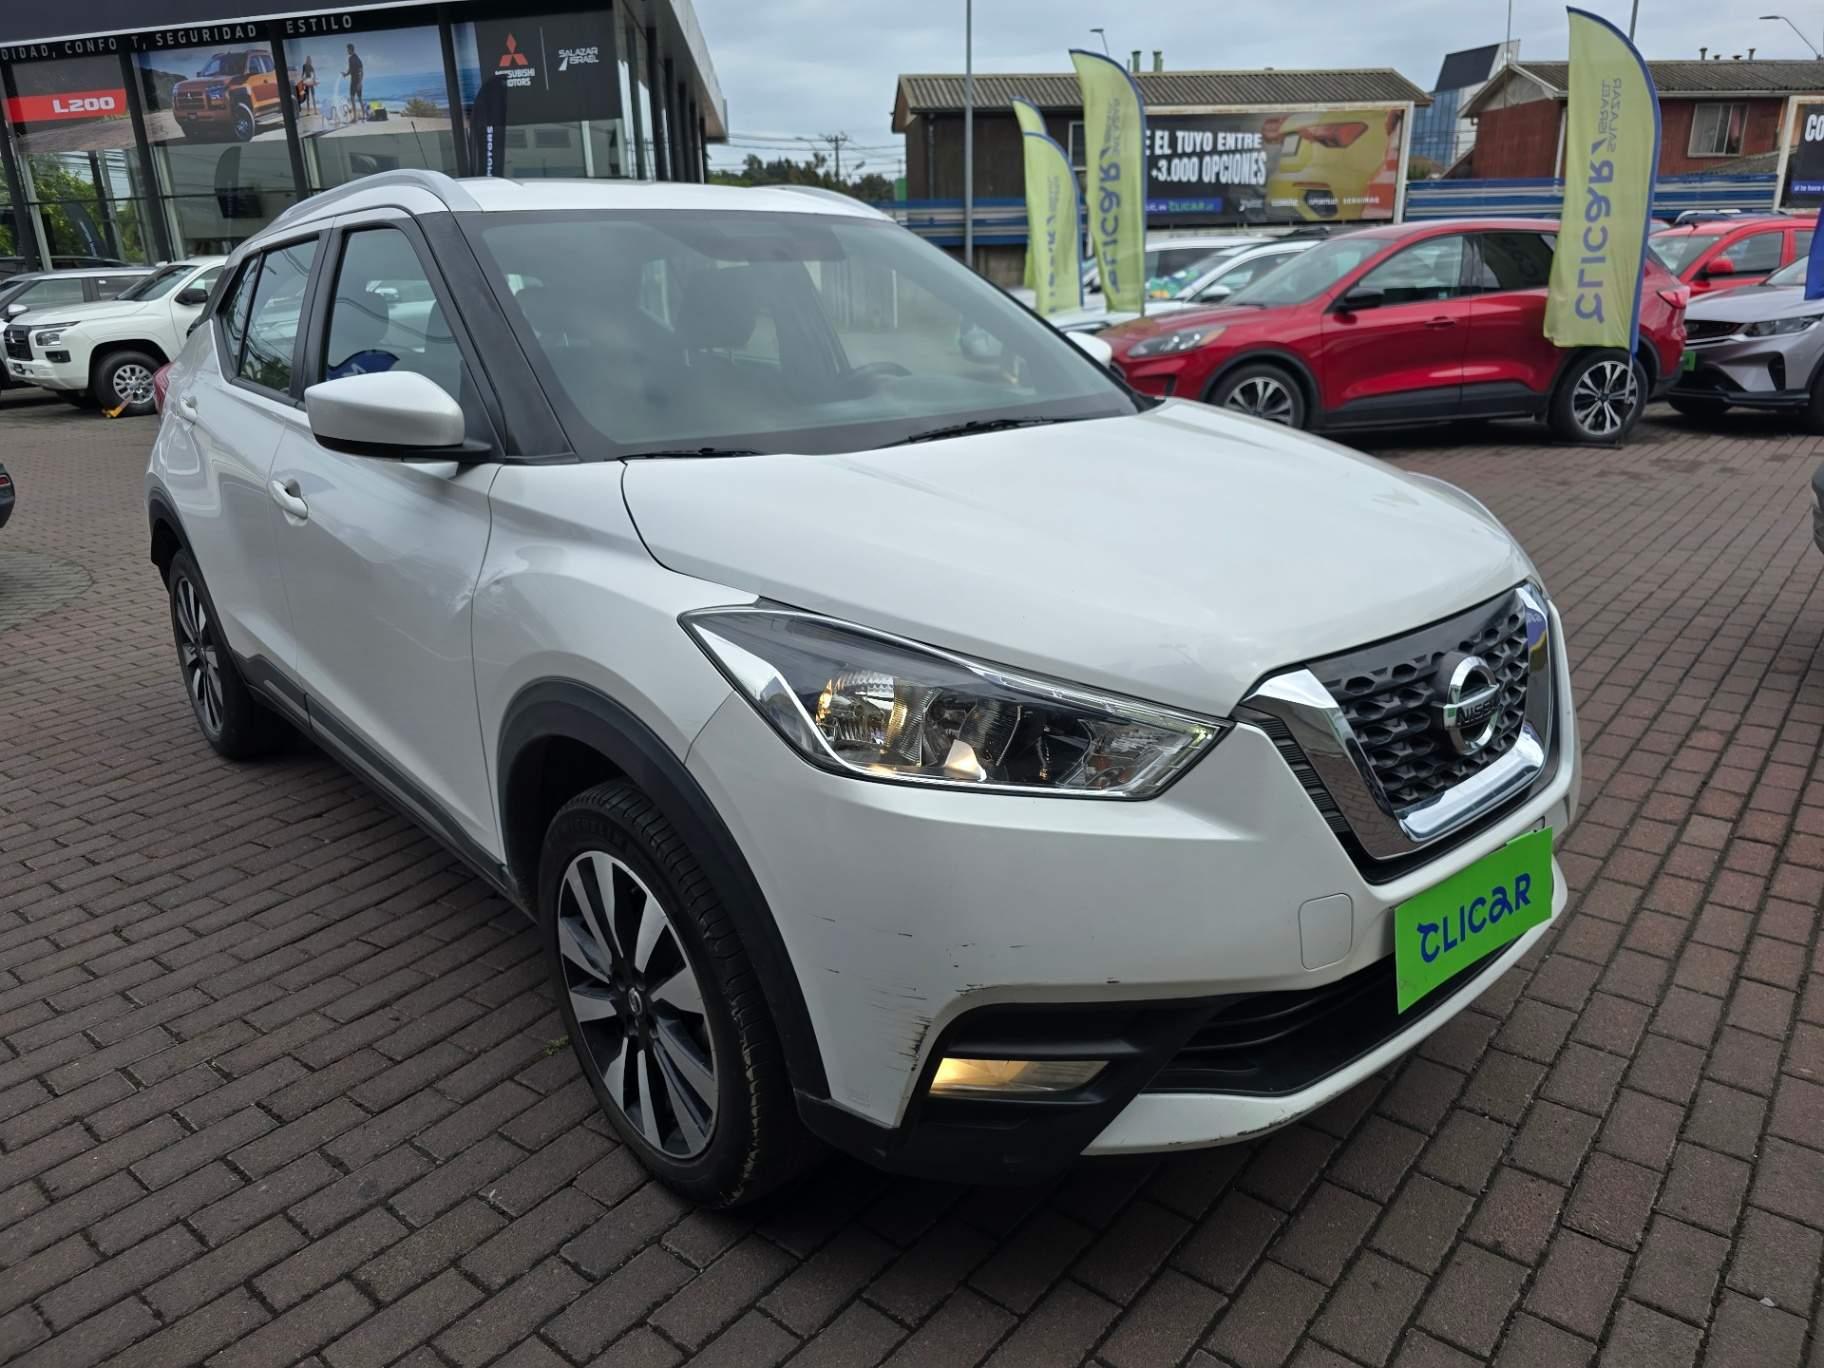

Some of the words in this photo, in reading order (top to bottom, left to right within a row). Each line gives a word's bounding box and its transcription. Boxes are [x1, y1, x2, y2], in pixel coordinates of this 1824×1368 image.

[64, 35, 147, 54] CONFOT,
[155, 24, 257, 46] SEGURIDAD
[286, 14, 352, 34] ESTILO
[506, 77, 531, 88] OTORS
[52, 96, 116, 113] L200
[1154, 129, 1172, 155] EL
[1175, 130, 1213, 154] TUYO
[1216, 131, 1263, 151] ENTRE
[1151, 157, 1200, 182] +3.000
[1202, 151, 1267, 185] OPCIONES
